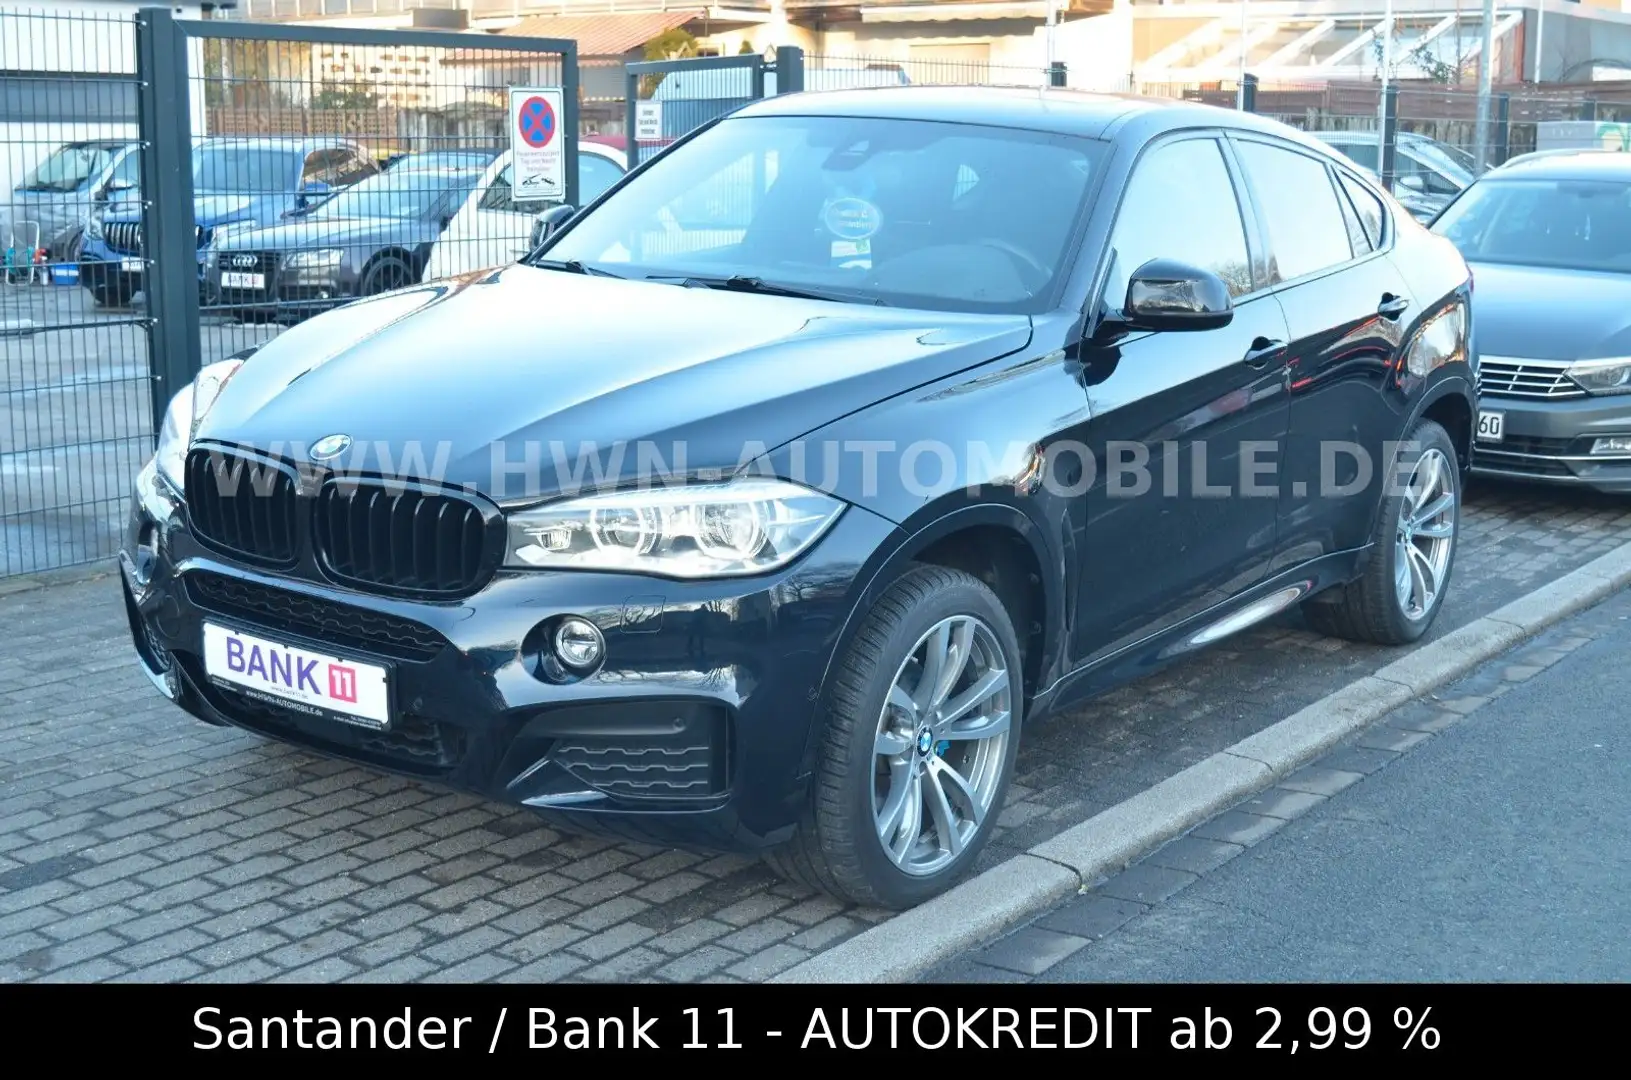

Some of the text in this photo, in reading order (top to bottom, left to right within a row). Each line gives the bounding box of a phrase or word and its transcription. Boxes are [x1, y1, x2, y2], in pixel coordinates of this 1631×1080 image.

[1479, 415, 1500, 435] 60
[226, 636, 353, 699] BANK 11
